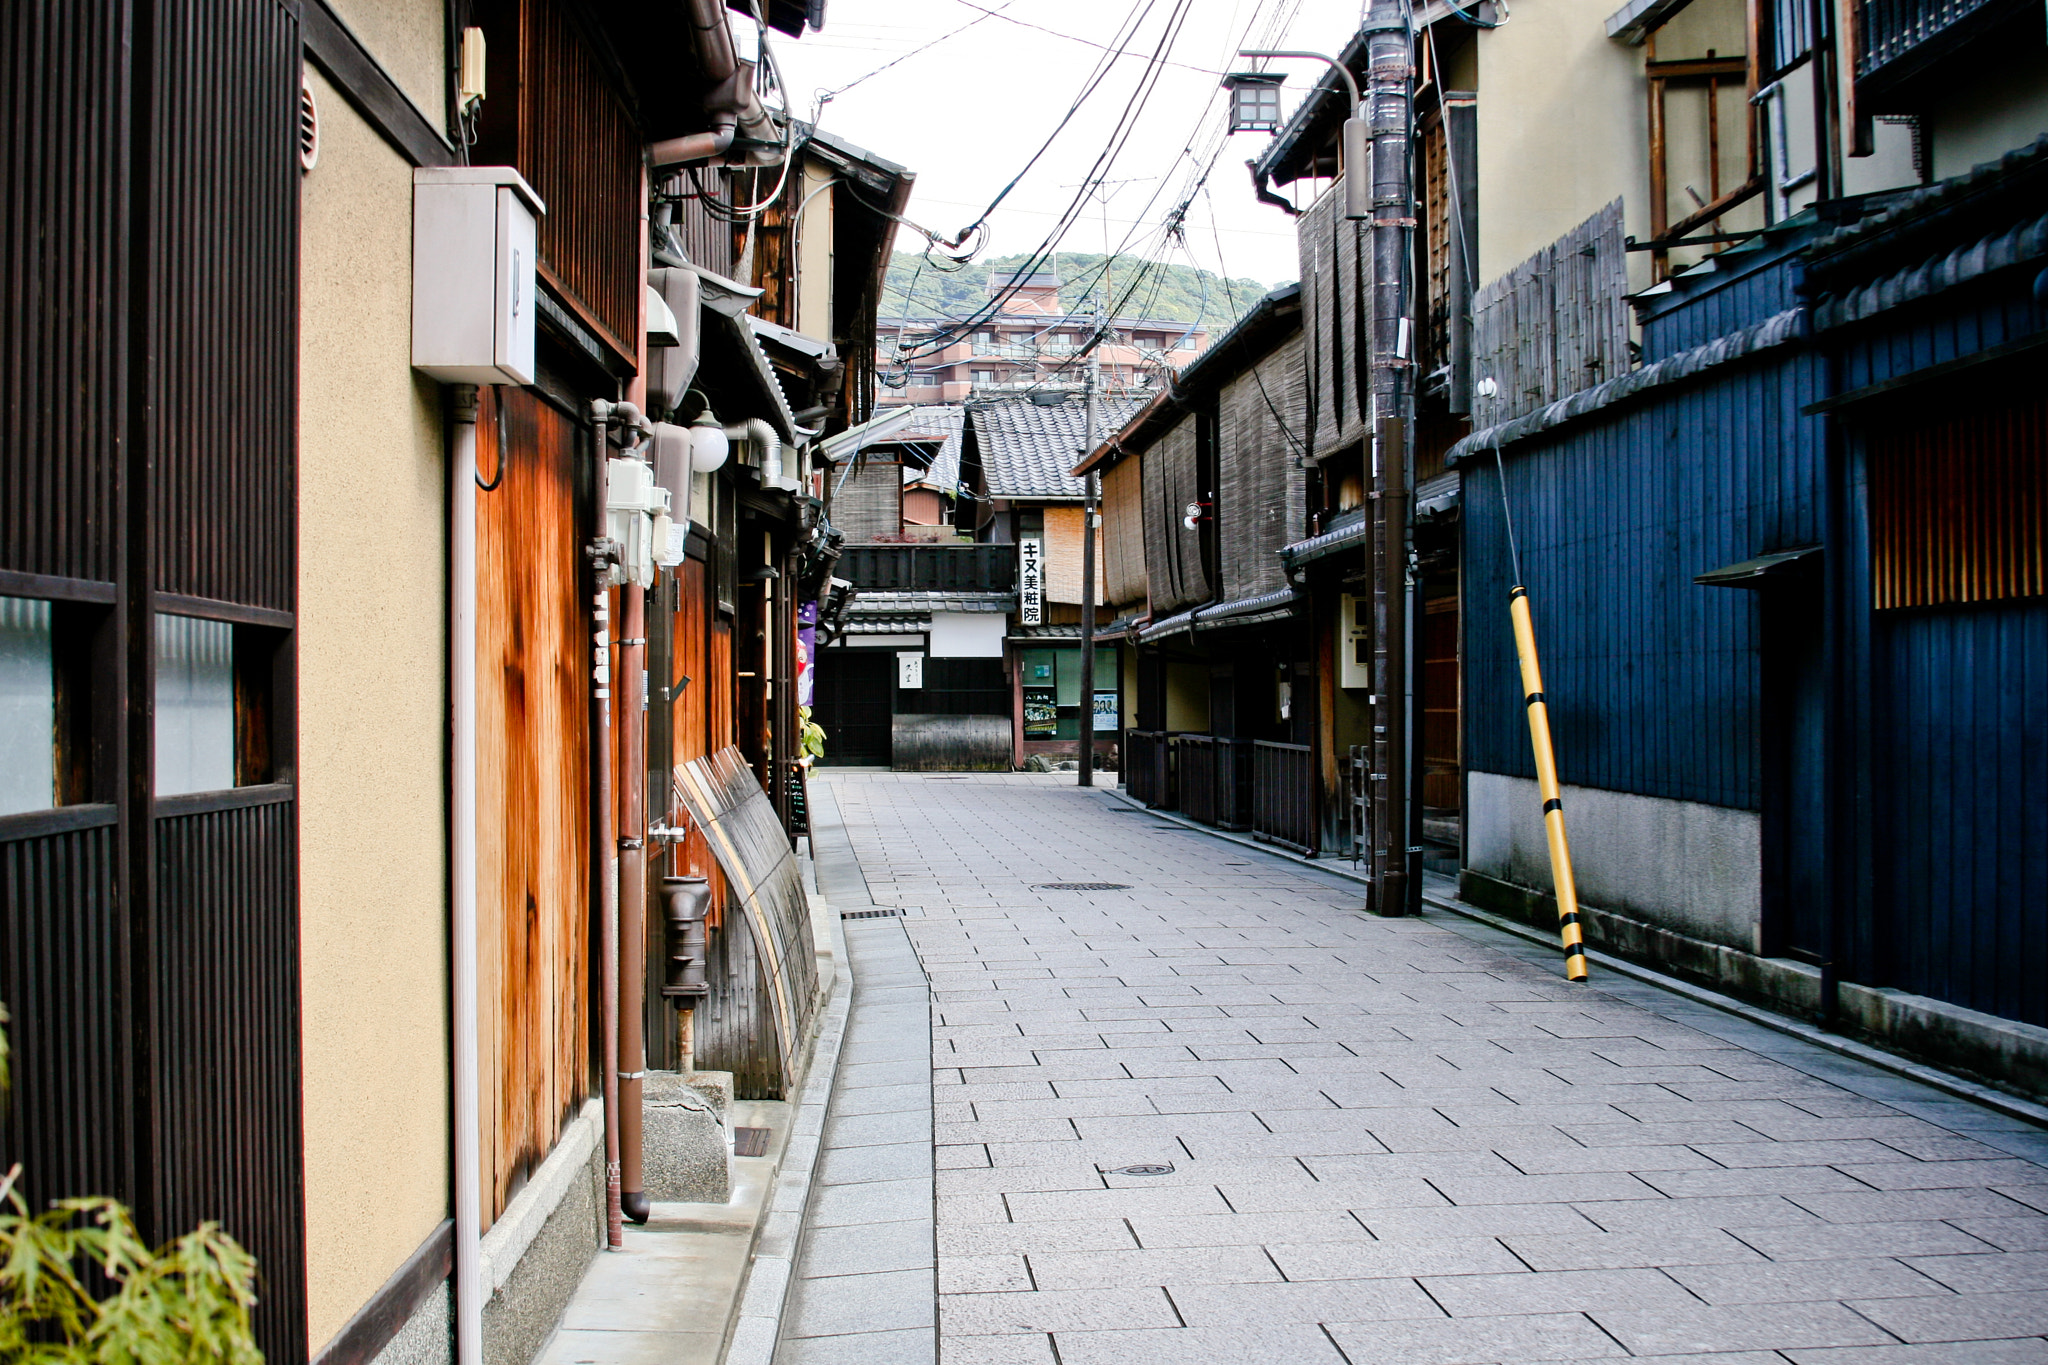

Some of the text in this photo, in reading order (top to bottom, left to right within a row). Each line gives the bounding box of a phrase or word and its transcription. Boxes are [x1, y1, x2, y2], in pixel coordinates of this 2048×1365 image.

[1023, 542, 1039, 622] キヌ美粧院
